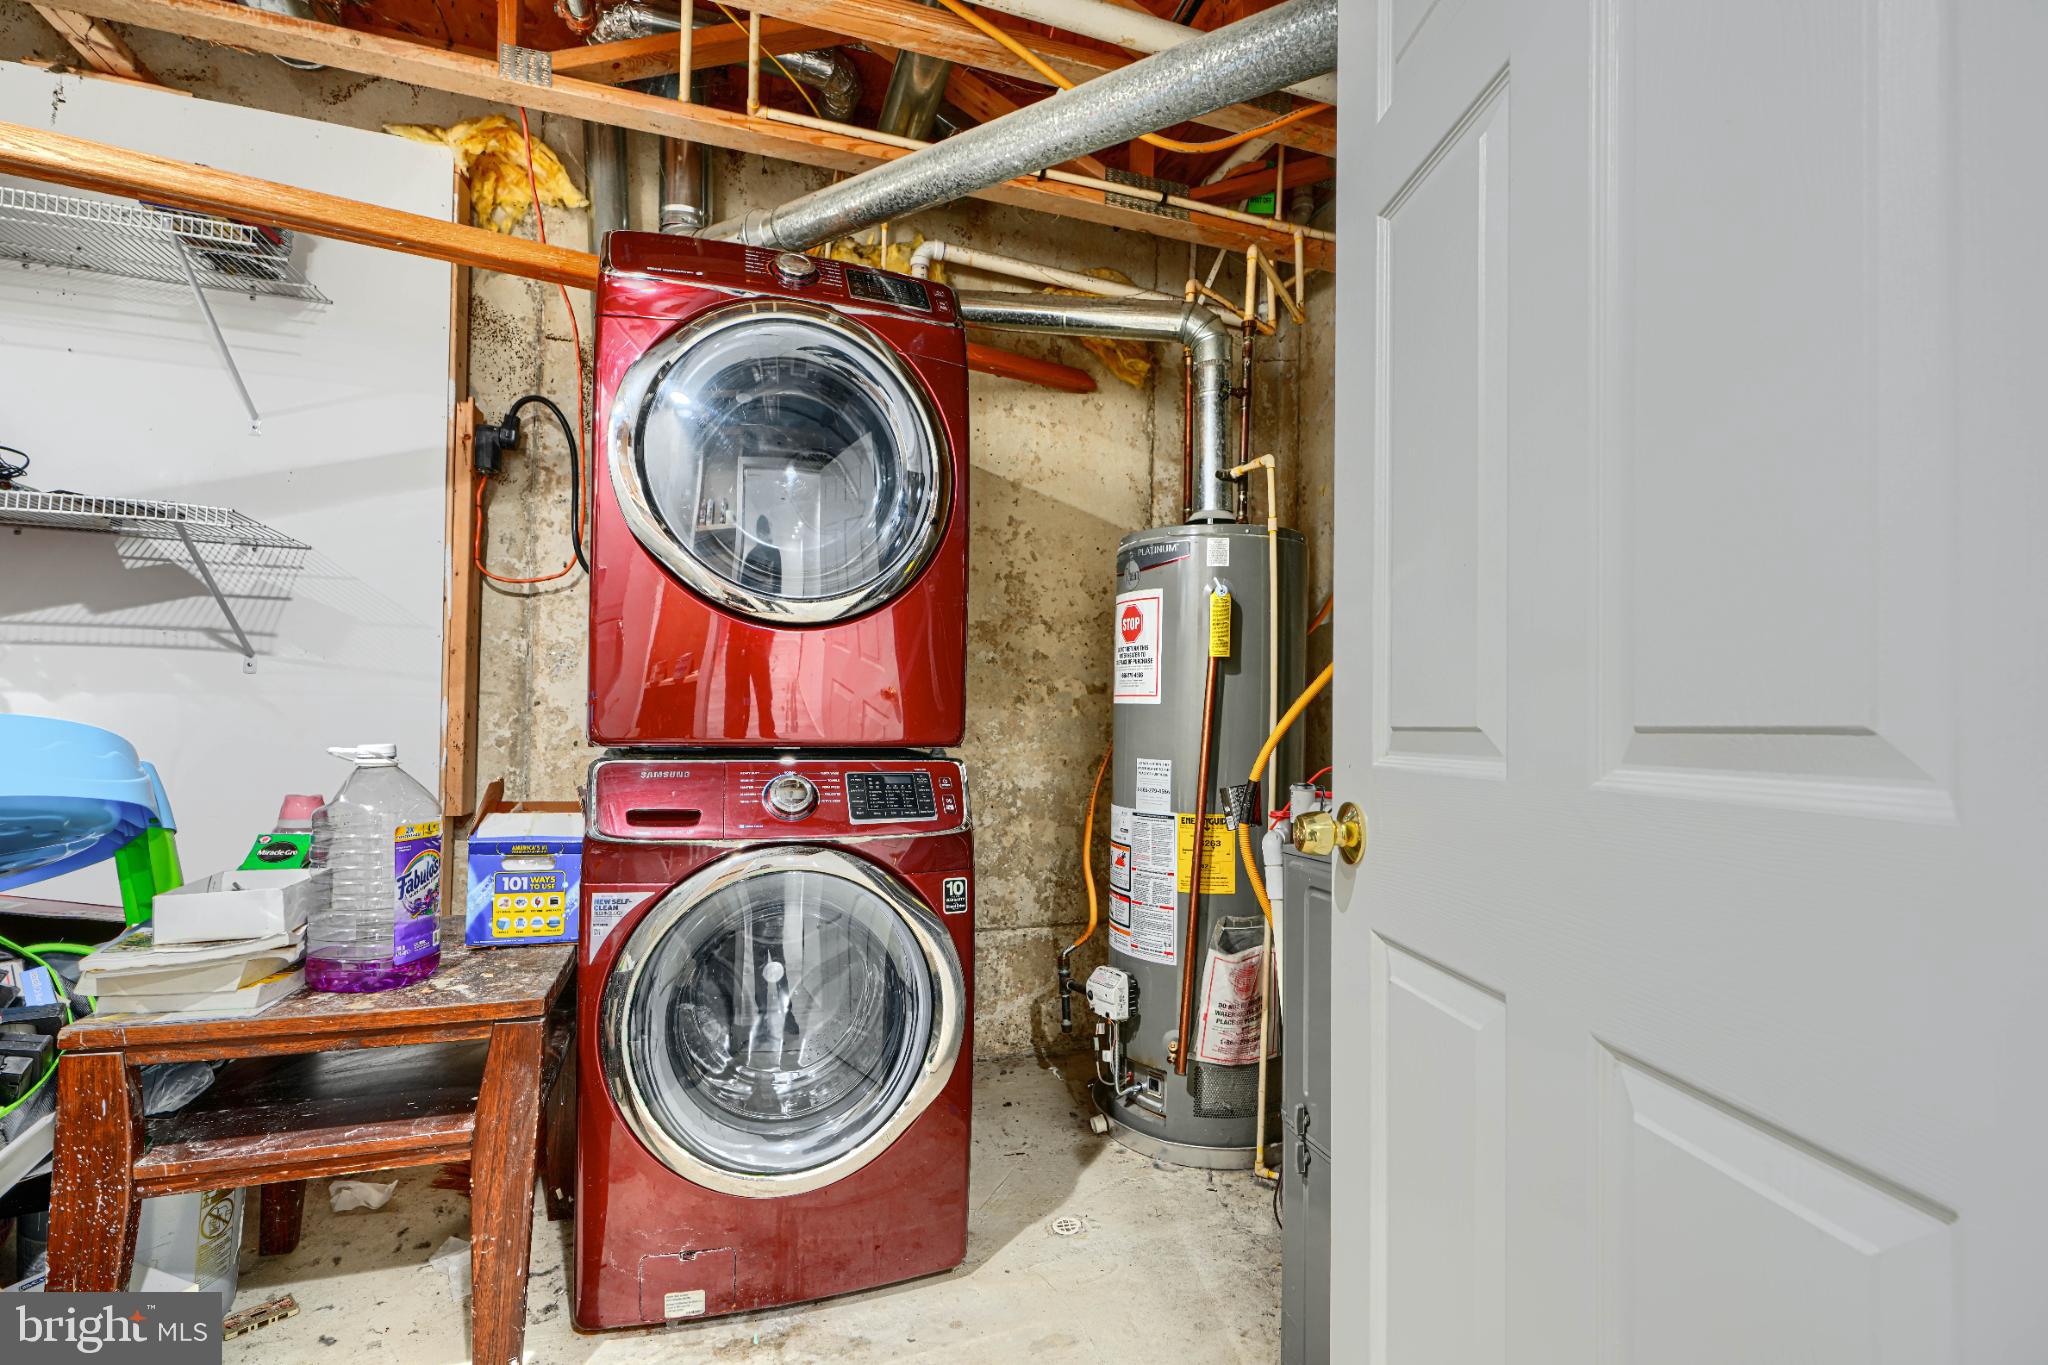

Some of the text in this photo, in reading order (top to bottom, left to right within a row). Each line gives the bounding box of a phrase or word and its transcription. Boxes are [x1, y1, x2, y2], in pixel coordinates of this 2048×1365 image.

[1137, 544, 1177, 557] PLATINUM
[1122, 618, 1140, 631] STOP
[640, 770, 690, 779] SAMSUNG
[1181, 816, 1228, 827] ENEYGUID
[502, 876, 528, 891] 101
[946, 880, 965, 896] 10
